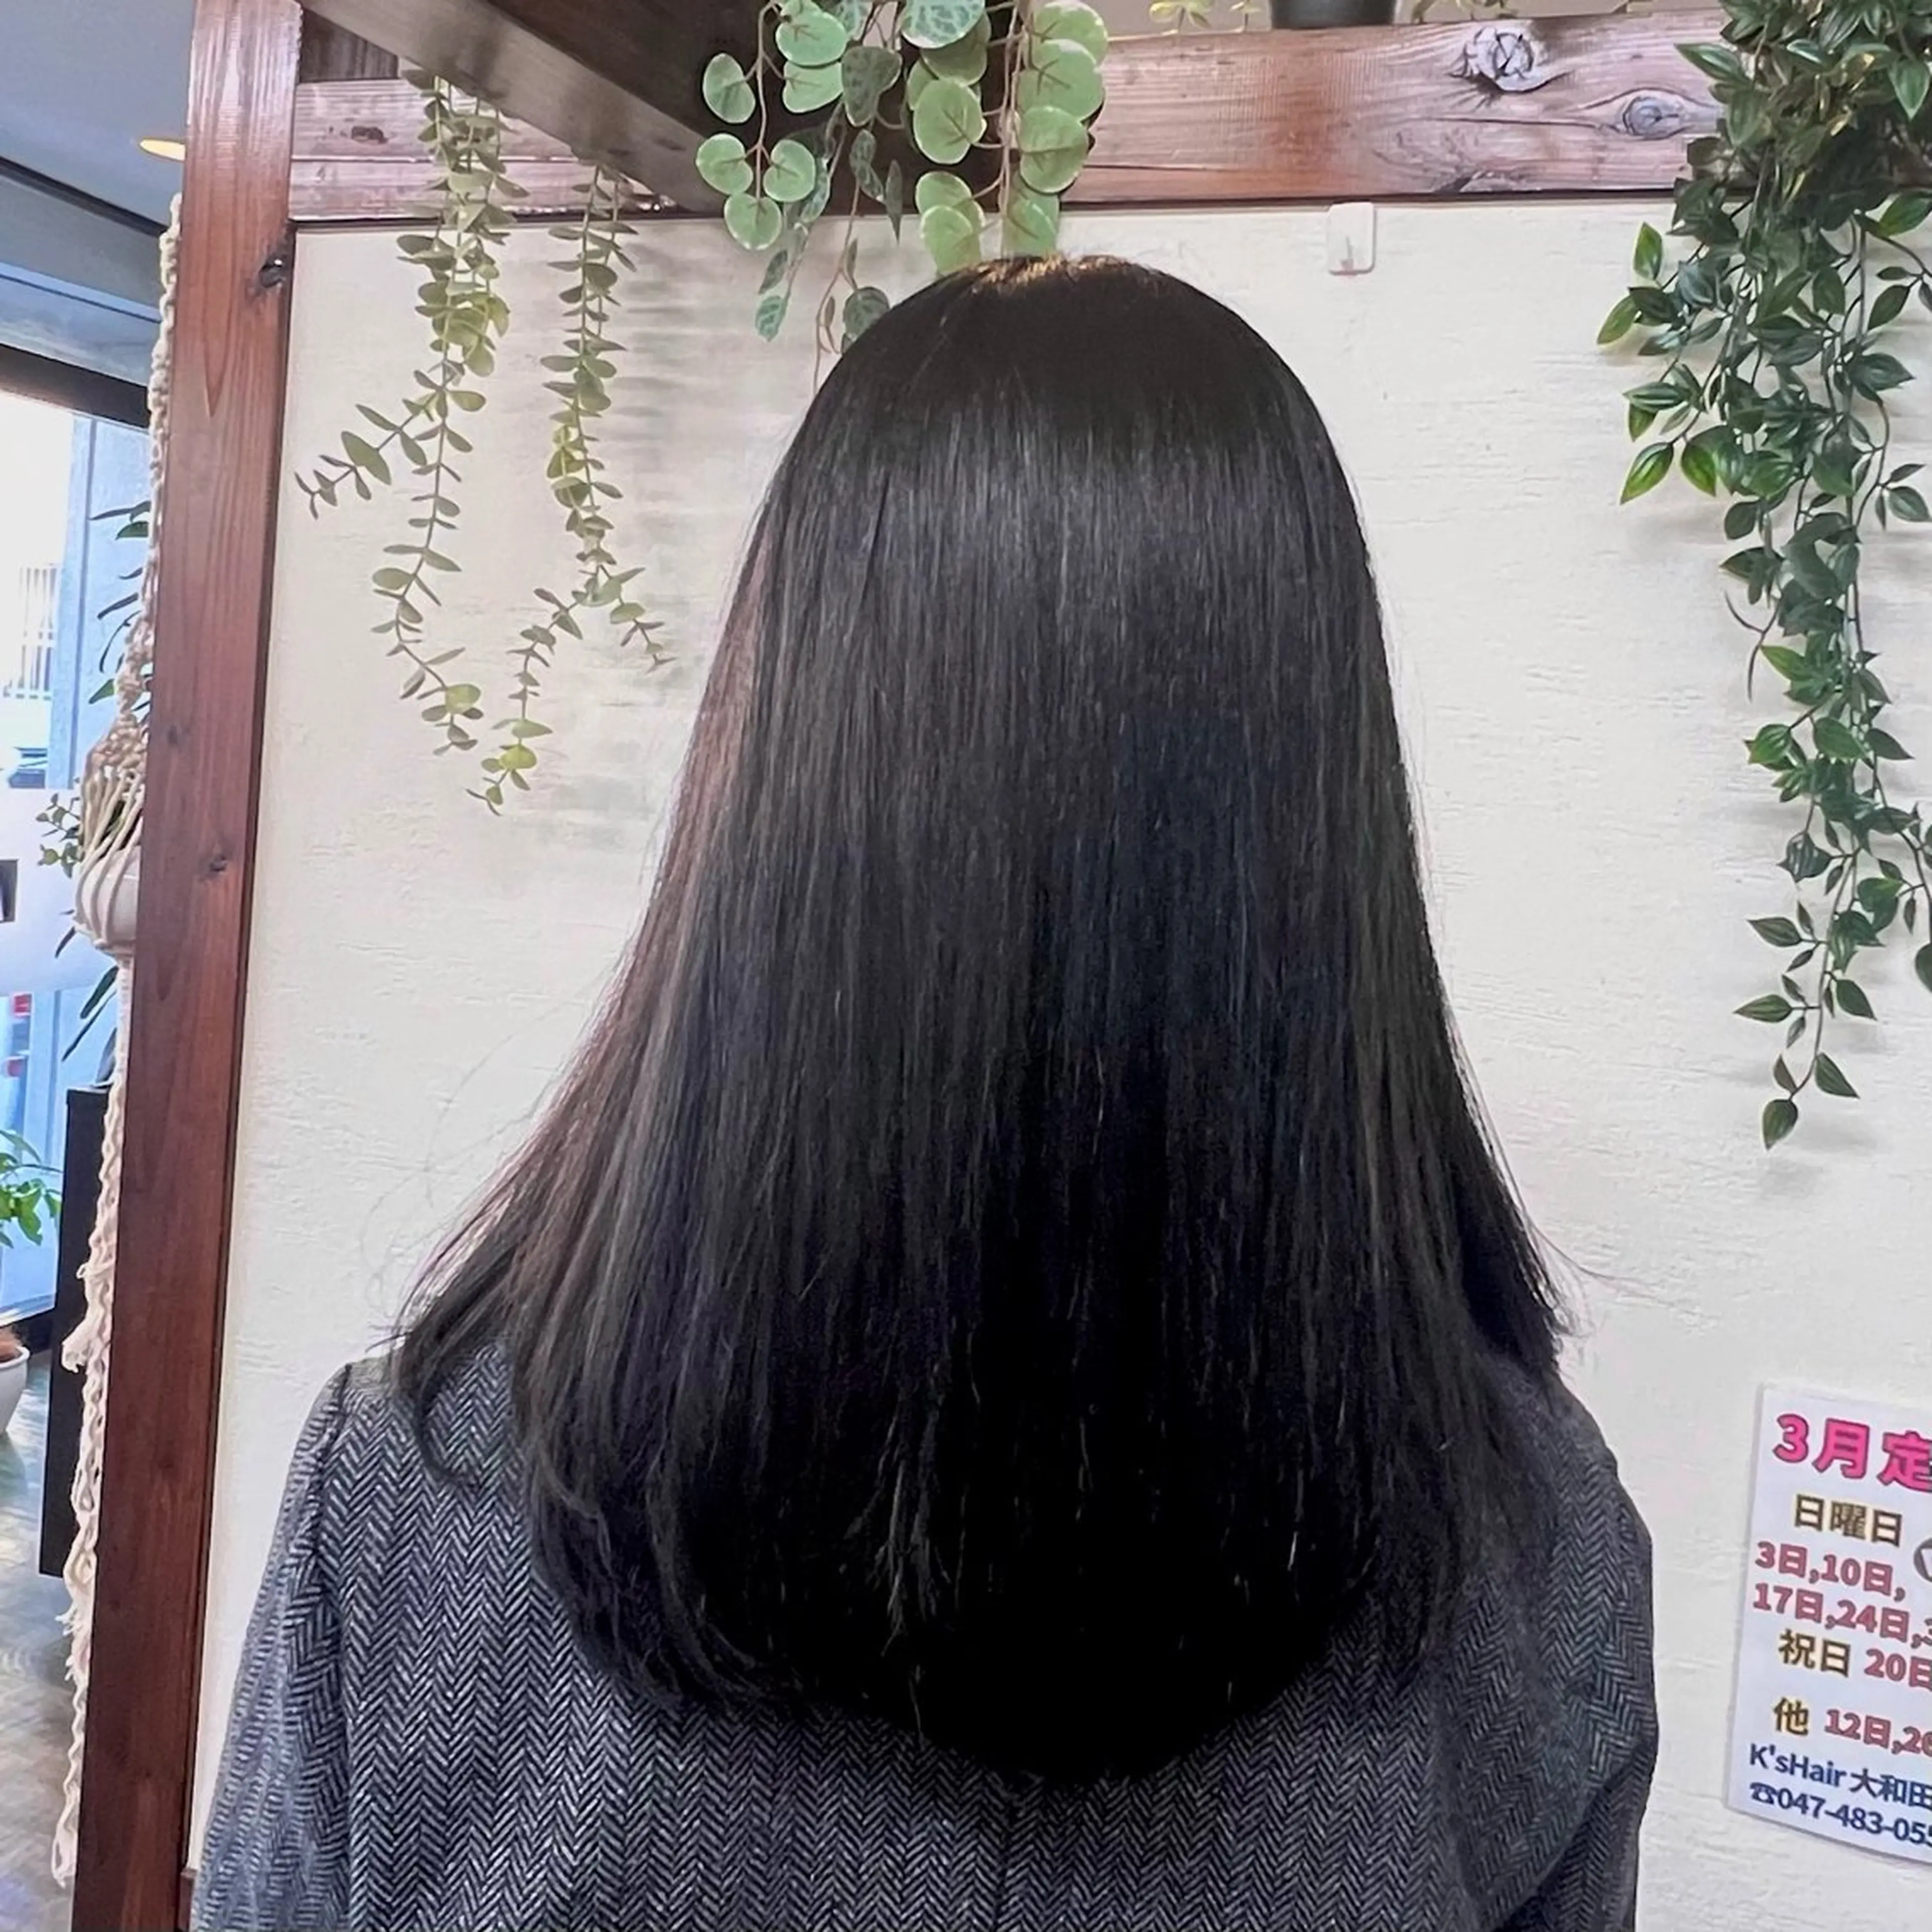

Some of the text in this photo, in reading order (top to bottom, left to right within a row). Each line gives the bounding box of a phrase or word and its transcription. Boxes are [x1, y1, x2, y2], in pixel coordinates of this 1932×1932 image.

[1773, 1414, 1932, 1493] 3月定
[1795, 1493, 1902, 1547] 日曜日
[1778, 1629, 1932, 1692] 祝日 20日
[1773, 1698, 1809, 1736] 他
[1749, 1743, 1932, 1811] K'sHair 大和田
